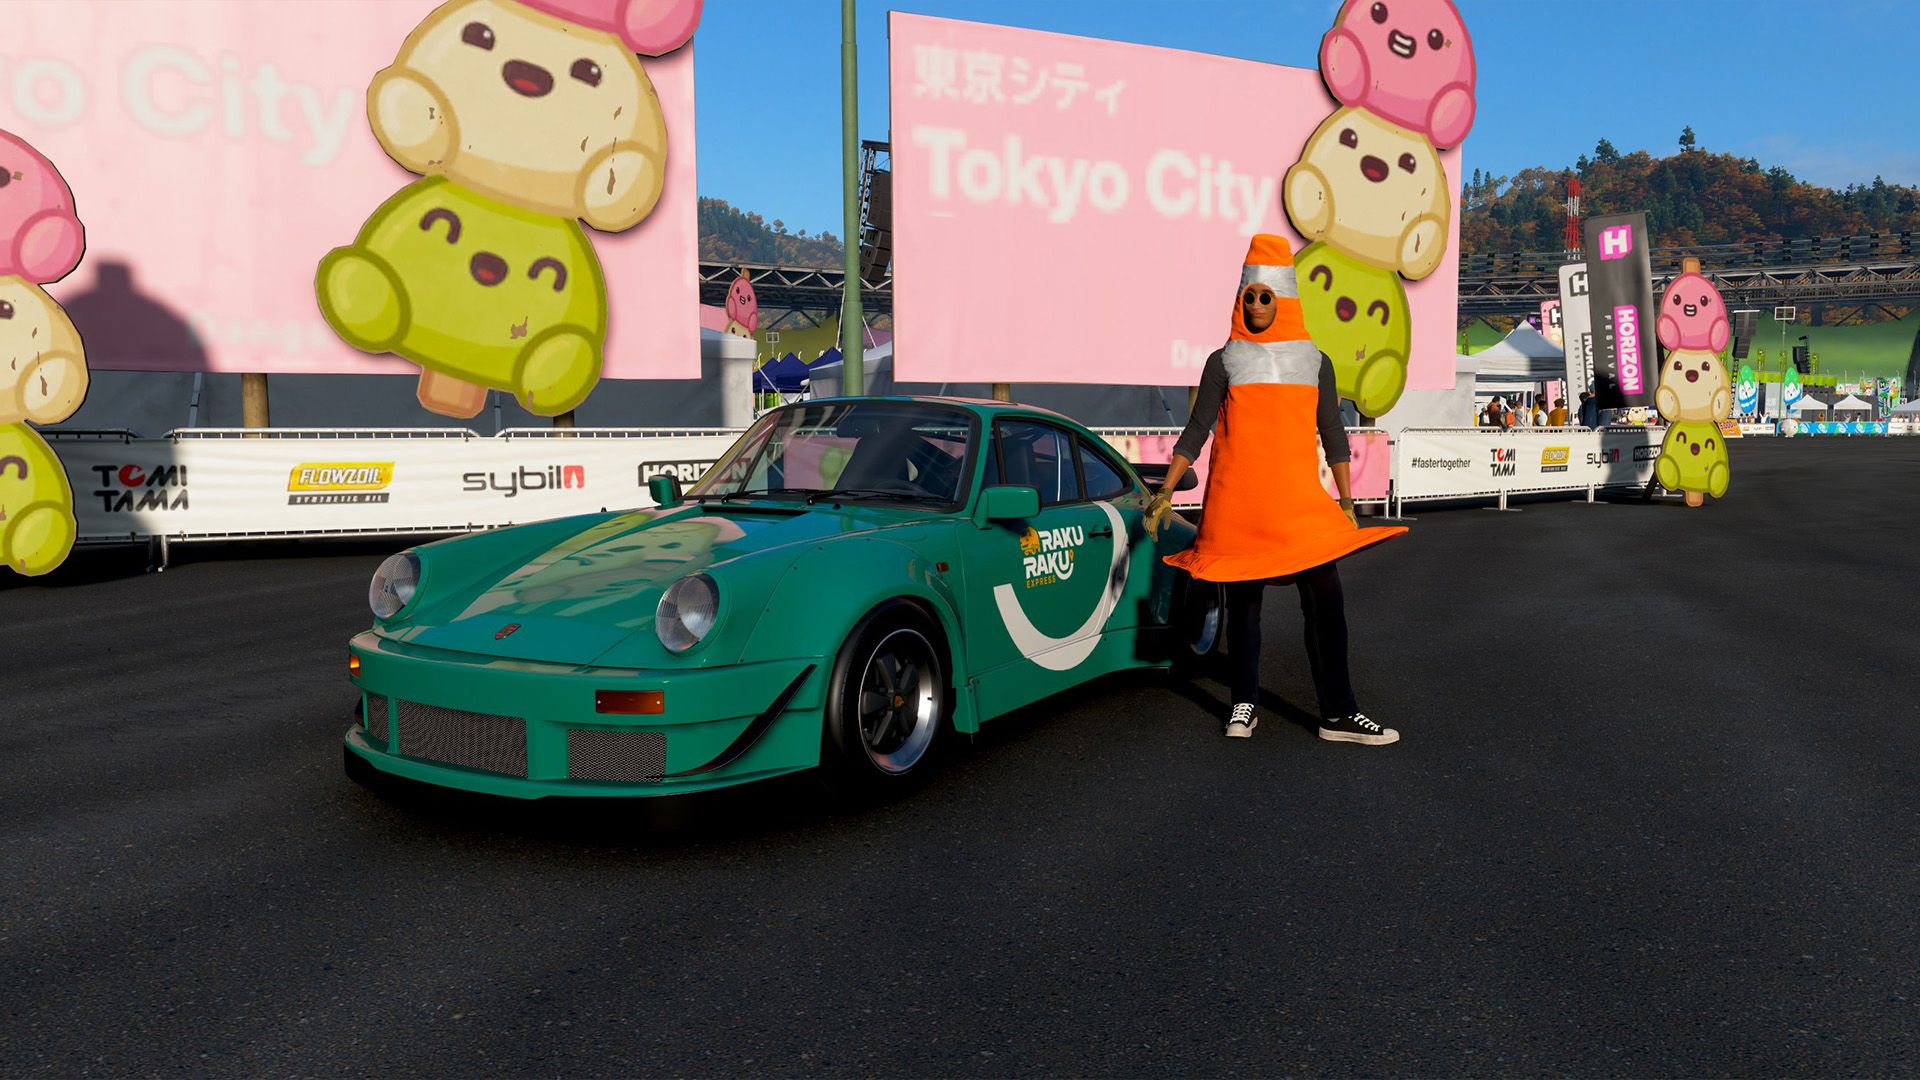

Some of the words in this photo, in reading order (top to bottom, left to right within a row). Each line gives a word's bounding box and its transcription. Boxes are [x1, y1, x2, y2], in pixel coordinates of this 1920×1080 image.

[913, 43, 1126, 118] 東京シティ
[120, 42, 361, 168] City
[912, 125, 1130, 224] Tokyo
[1145, 149, 1274, 236] City
[1604, 230, 1627, 254] H
[1604, 314, 1616, 389] FESTIVAL
[1617, 309, 1640, 391] HORIZON
[1412, 457, 1471, 471] #fastertogether
[1491, 448, 1515, 462] TOMI
[92, 464, 187, 488] TOMI
[299, 467, 382, 485] FLOWZOIL
[1491, 463, 1515, 476] TAMA
[93, 489, 189, 513] TAMA
[1038, 525, 1084, 552] RAKU
[1026, 575, 1057, 589] EXPRESS
